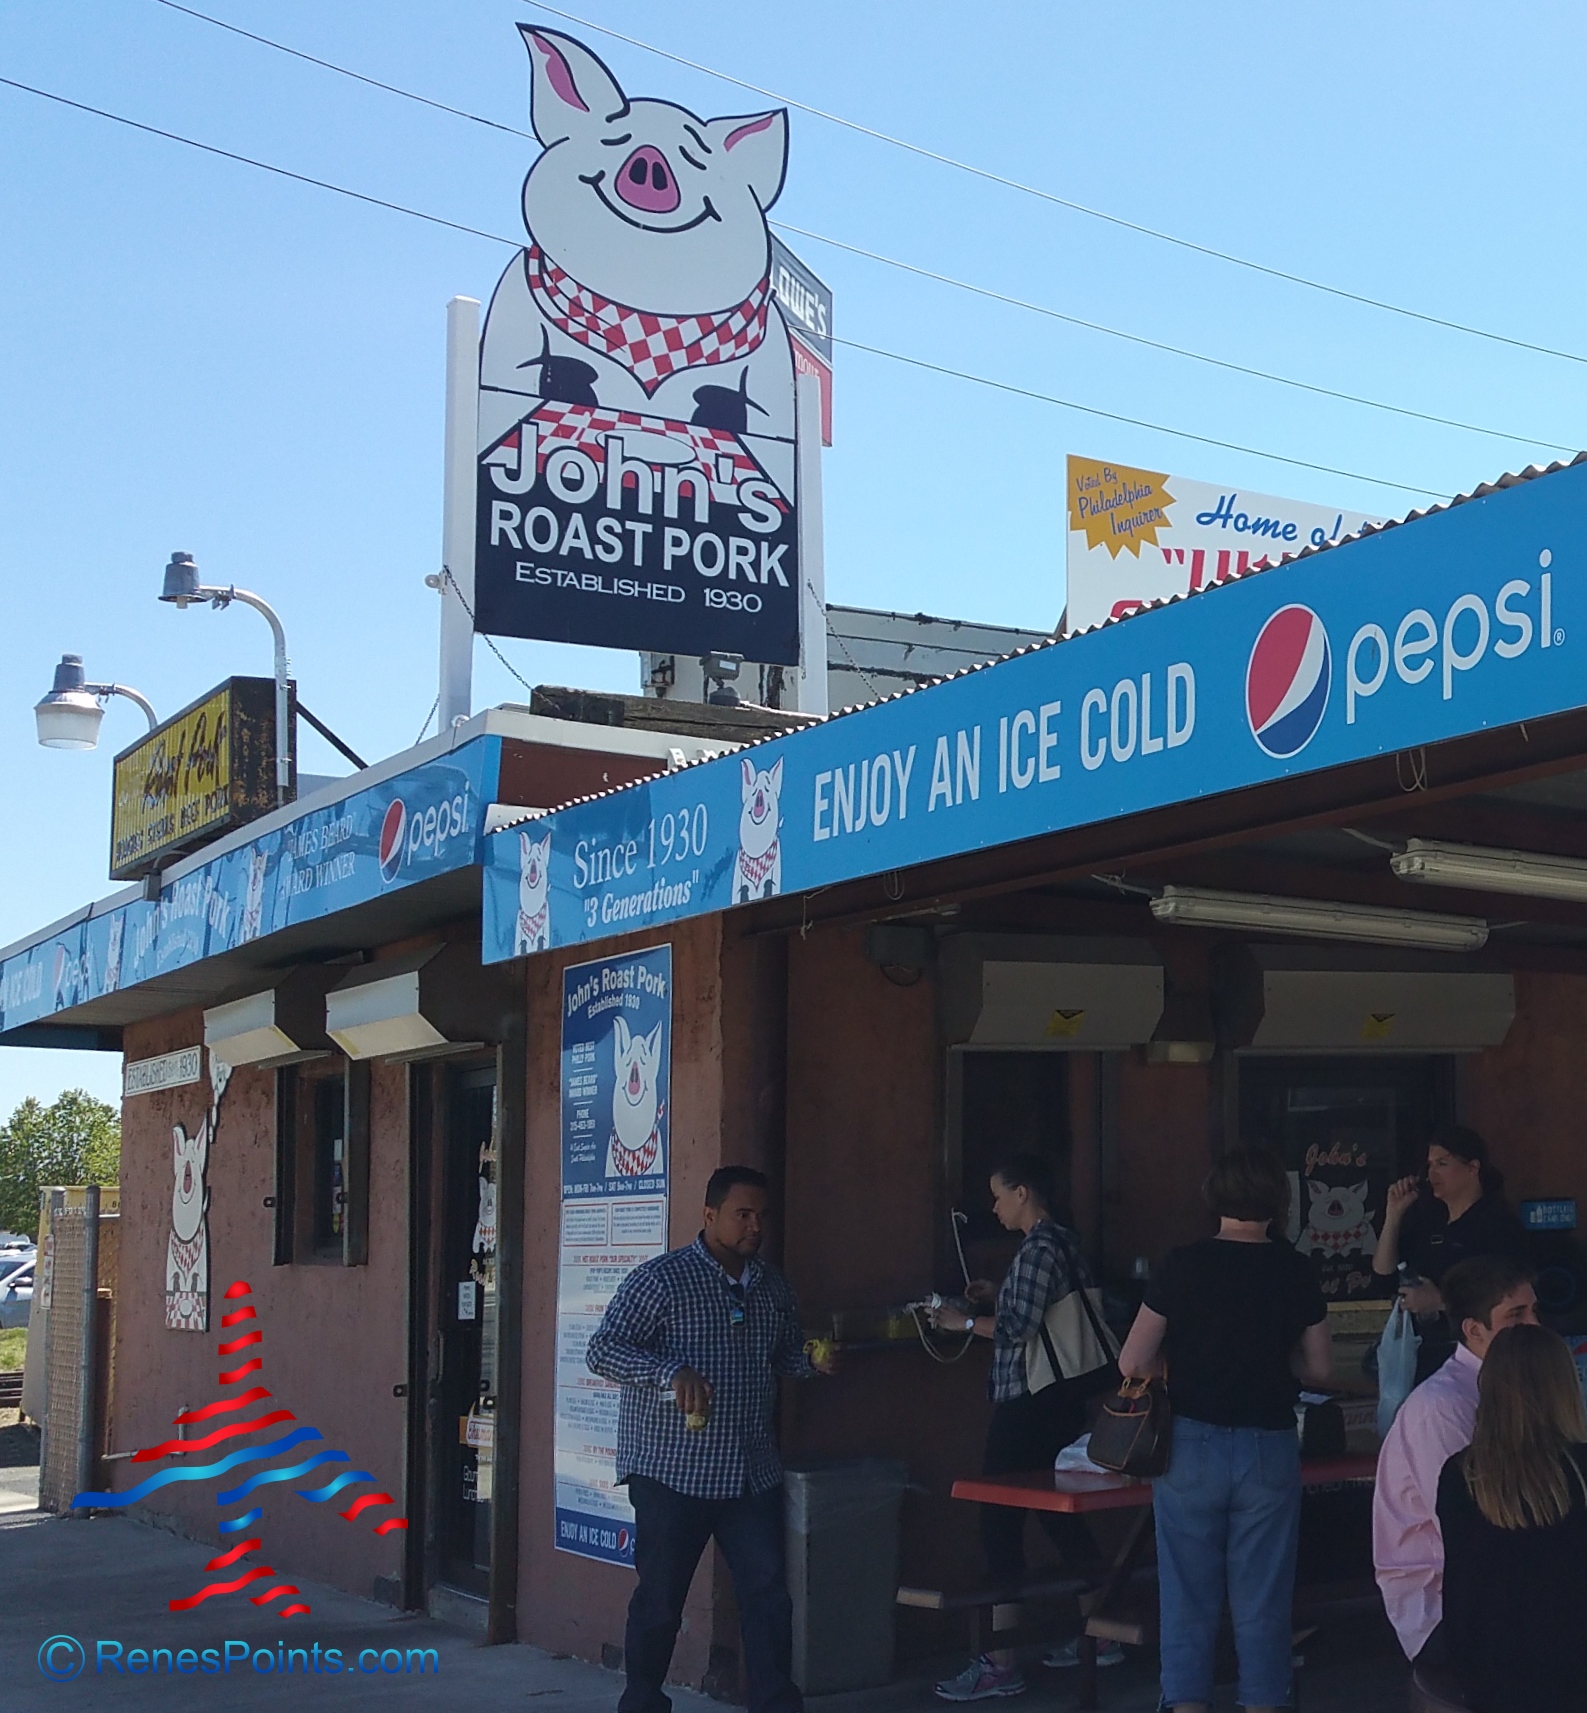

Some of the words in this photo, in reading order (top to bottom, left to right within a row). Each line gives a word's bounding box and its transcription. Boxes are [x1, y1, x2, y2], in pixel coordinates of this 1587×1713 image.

[489, 422, 783, 534] John's
[1076, 473, 1101, 492] Voted
[1103, 467, 1118, 484] By
[1078, 481, 1153, 519] Philadelphia
[1110, 507, 1162, 538] Inquirer
[1195, 493, 1298, 542] Home
[491, 500, 652, 567] ROAST
[663, 527, 790, 588] PORK
[515, 561, 686, 603] ESTABLISHED
[703, 587, 763, 614] 1930
[814, 747, 914, 842] ENJOY
[928, 730, 981, 816] AN
[998, 700, 1061, 795] ICE
[1080, 662, 1196, 771] COLD
[1346, 548, 1552, 726] pepsi
[407, 781, 469, 864] pepsi
[572, 835, 638, 890] Since
[646, 802, 708, 870] 1930
[315, 851, 356, 888] WINNER
[170, 874, 202, 921] Roast
[201, 876, 230, 939] Pork
[583, 892, 600, 927] "3
[602, 873, 701, 924] Generations"
[567, 975, 599, 1017] John's
[602, 965, 635, 991] Roast
[637, 965, 666, 999] Pork
[588, 993, 623, 1019] Established
[625, 993, 641, 1010] 1930
[180, 1052, 198, 1079] 1930
[1305, 1142, 1367, 1176] John's
[560, 1520, 578, 1540] ENJOY
[579, 1525, 588, 1543] AN
[589, 1527, 599, 1546] ICE
[600, 1530, 616, 1550] COLD
